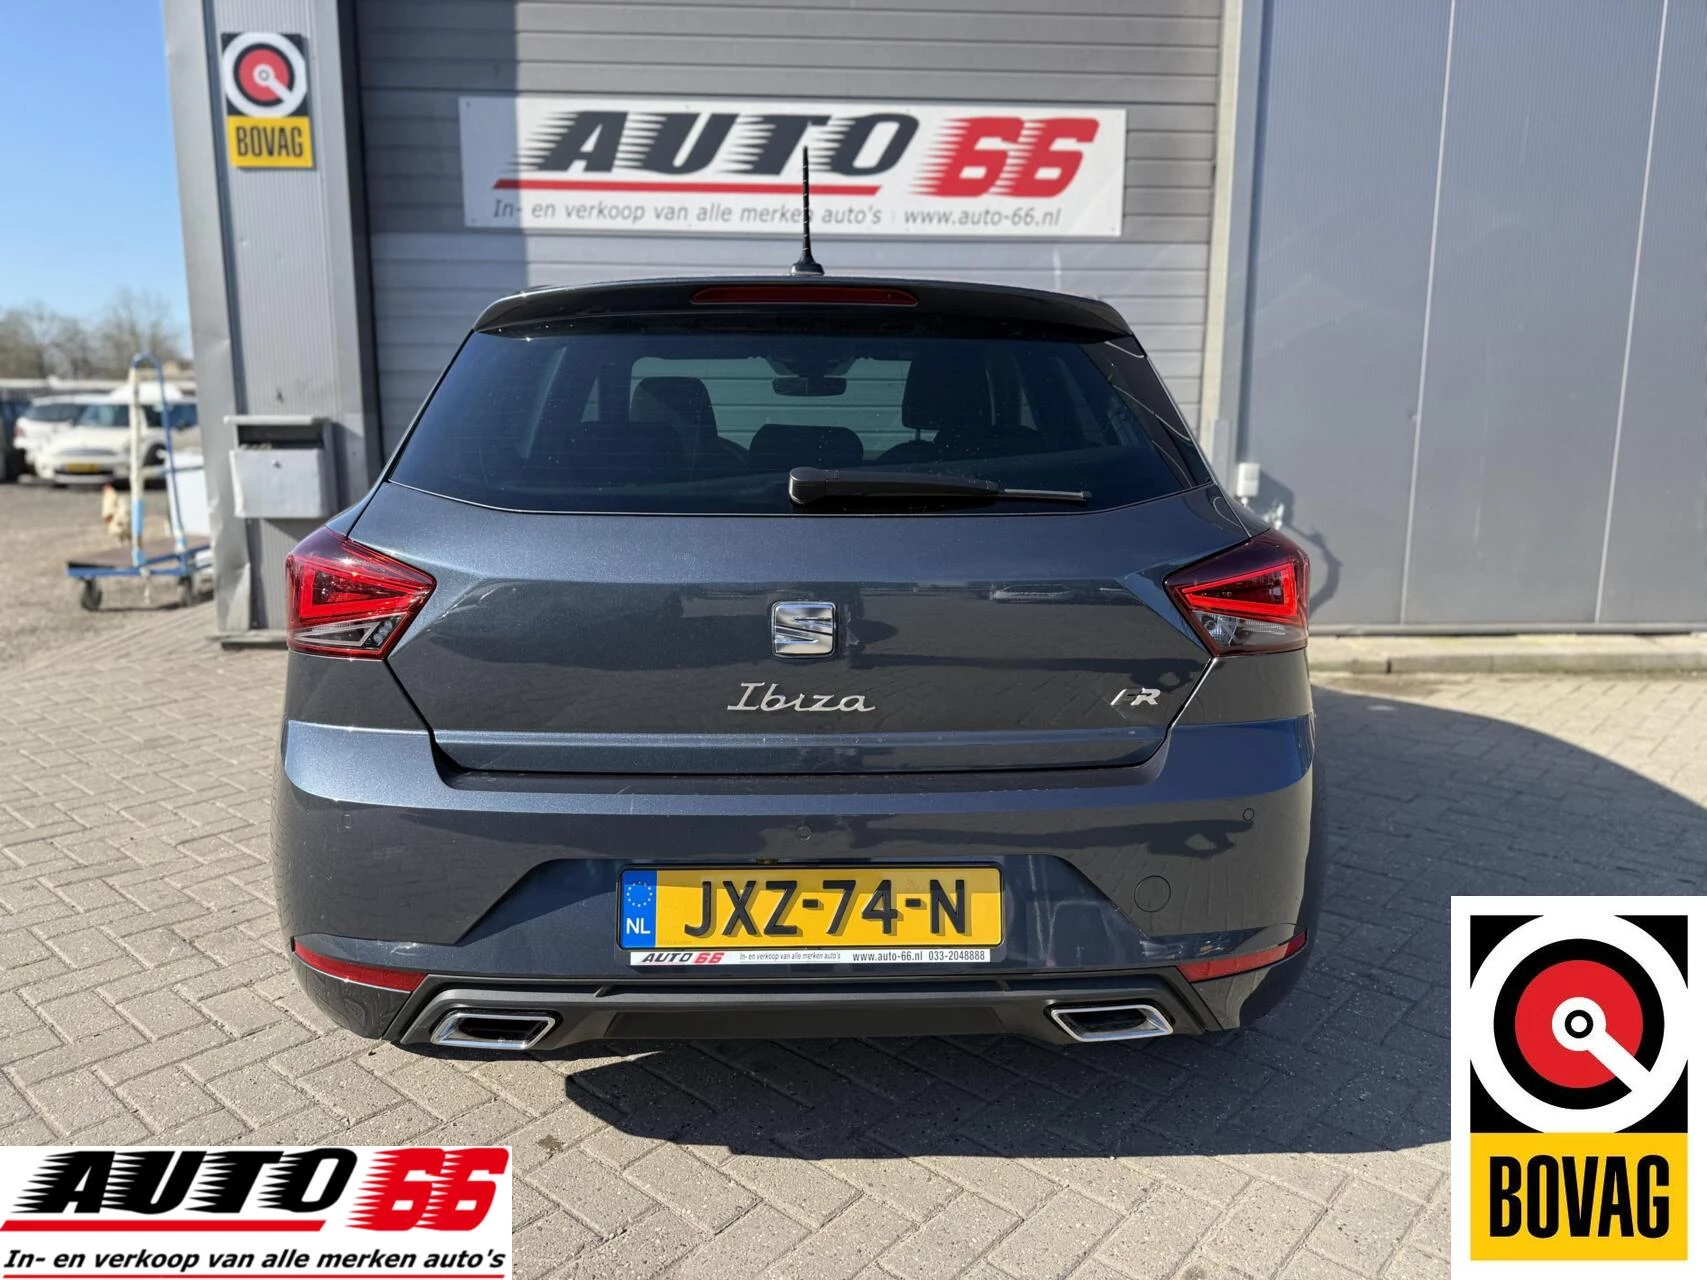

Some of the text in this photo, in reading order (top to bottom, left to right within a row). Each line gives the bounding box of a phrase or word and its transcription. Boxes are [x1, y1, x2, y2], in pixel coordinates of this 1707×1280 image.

[235, 126, 304, 158] BOVAG
[504, 110, 1100, 198] AUTO 66
[493, 198, 522, 218] In-
[531, 203, 556, 218] en
[564, 201, 645, 223] verkoop
[653, 205, 689, 222] van
[696, 203, 732, 222] alle
[821, 206, 882, 225] auto's
[904, 207, 1061, 227] www.auto-66.nl
[727, 682, 876, 712] Ibiza
[684, 879, 965, 937] JXZ-74-N
[626, 917, 651, 935] NL
[642, 952, 725, 964] AUTO 66
[757, 952, 779, 962] verkoop
[803, 952, 823, 960] merken
[824, 951, 841, 960] auto's
[852, 950, 985, 962] www.auto-66.nl 033-2048888
